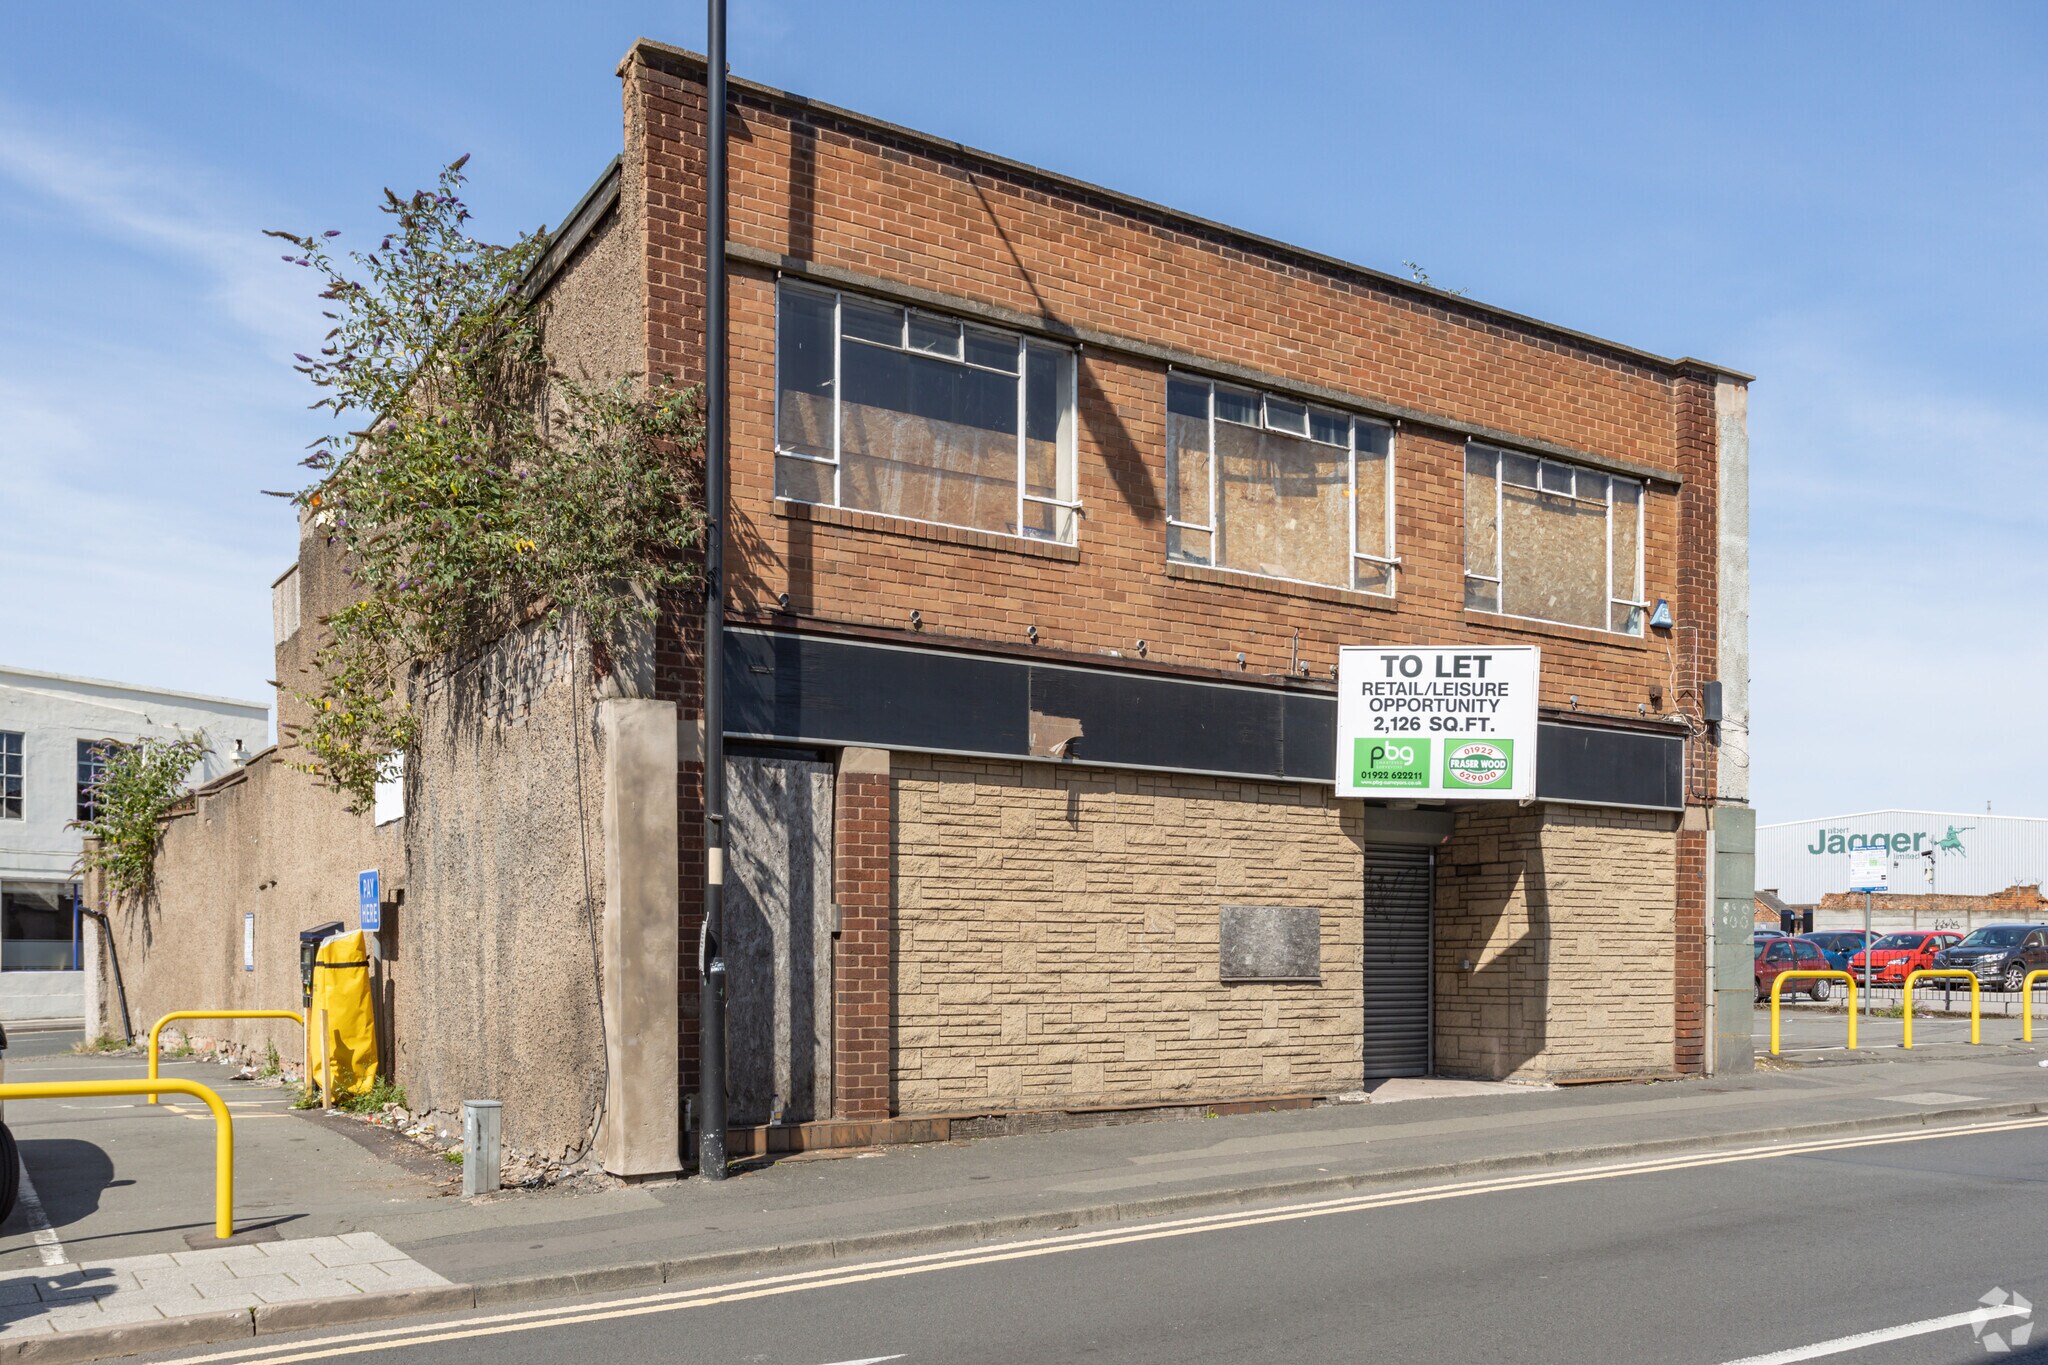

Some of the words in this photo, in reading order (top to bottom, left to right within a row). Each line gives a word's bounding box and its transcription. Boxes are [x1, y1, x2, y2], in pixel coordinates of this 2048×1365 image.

[1380, 654, 1423, 678] TO
[1435, 655, 1492, 678] LET
[1362, 682, 1509, 697] RETAIL/LEISURE
[1369, 698, 1501, 713] OPPORTUNITY
[1373, 716, 1421, 734] 2,126
[1429, 717, 1495, 732] SQ.FT.
[1370, 740, 1414, 769] pbg
[1463, 746, 1493, 755] 01922
[1450, 759, 1479, 768] FRASER
[1480, 759, 1506, 769] WOOD
[1361, 771, 1389, 779] 01922
[1391, 771, 1422, 780] 622211
[1459, 771, 1497, 782] 629000
[363, 878, 374, 898] PAY
[361, 903, 378, 923] HERE
